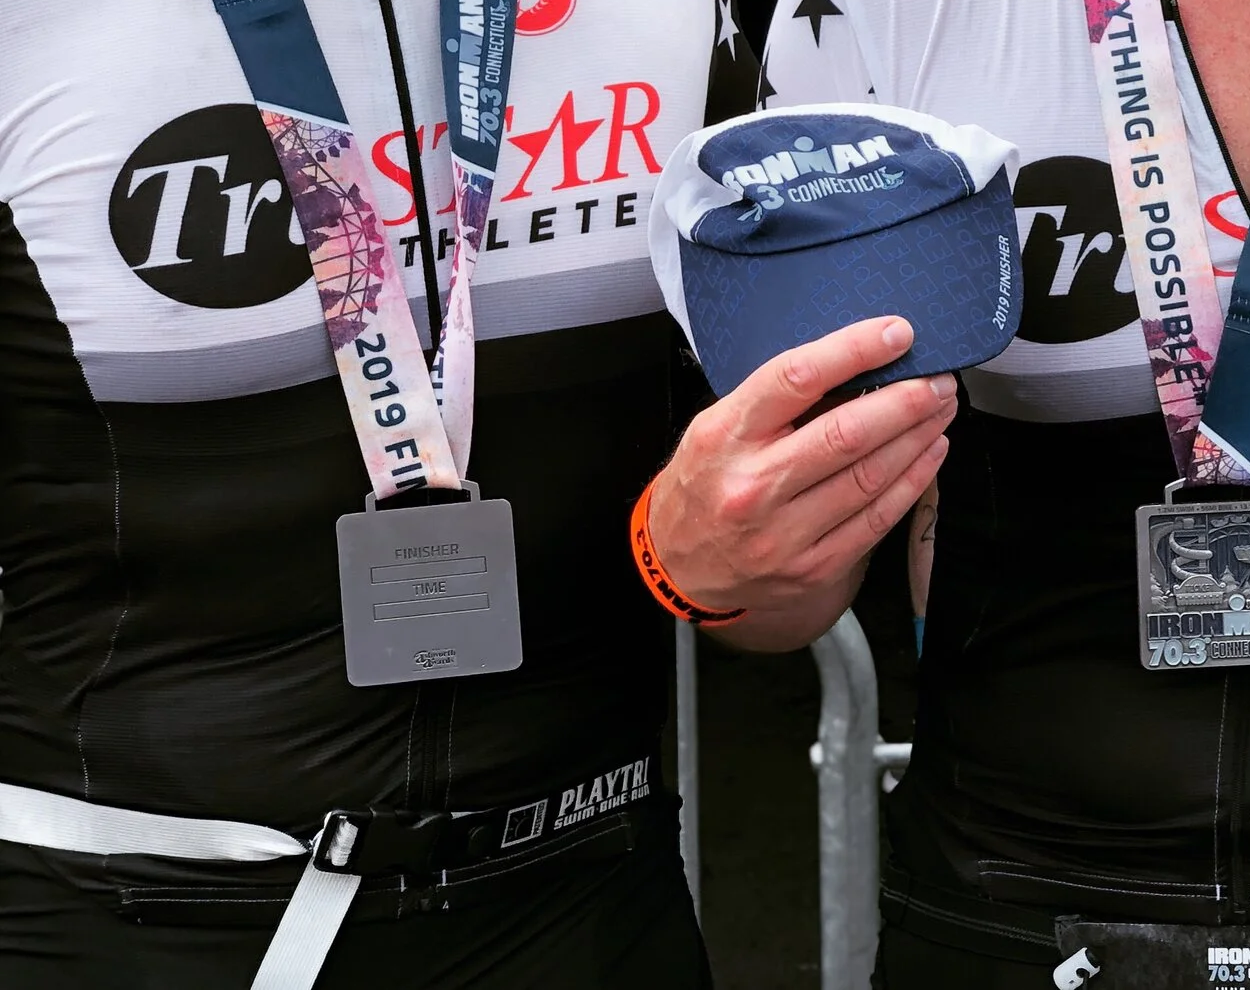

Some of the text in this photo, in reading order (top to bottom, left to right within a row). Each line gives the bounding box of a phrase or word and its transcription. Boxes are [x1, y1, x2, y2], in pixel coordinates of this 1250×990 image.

[479, 6, 507, 147] 70.3 CONNECTICUT
[787, 166, 888, 203] CONNECTICUT
[1131, 153, 1164, 189] IS
[399, 192, 638, 267] THLETE
[992, 234, 1011, 331] 2019 FINISHER
[355, 332, 407, 428] 2019
[394, 543, 460, 559] FINISHER
[412, 581, 447, 596] TIME
[1148, 638, 1208, 667] 70.3
[557, 756, 650, 818] PLAYTRI
[1208, 965, 1246, 982] 70.3
